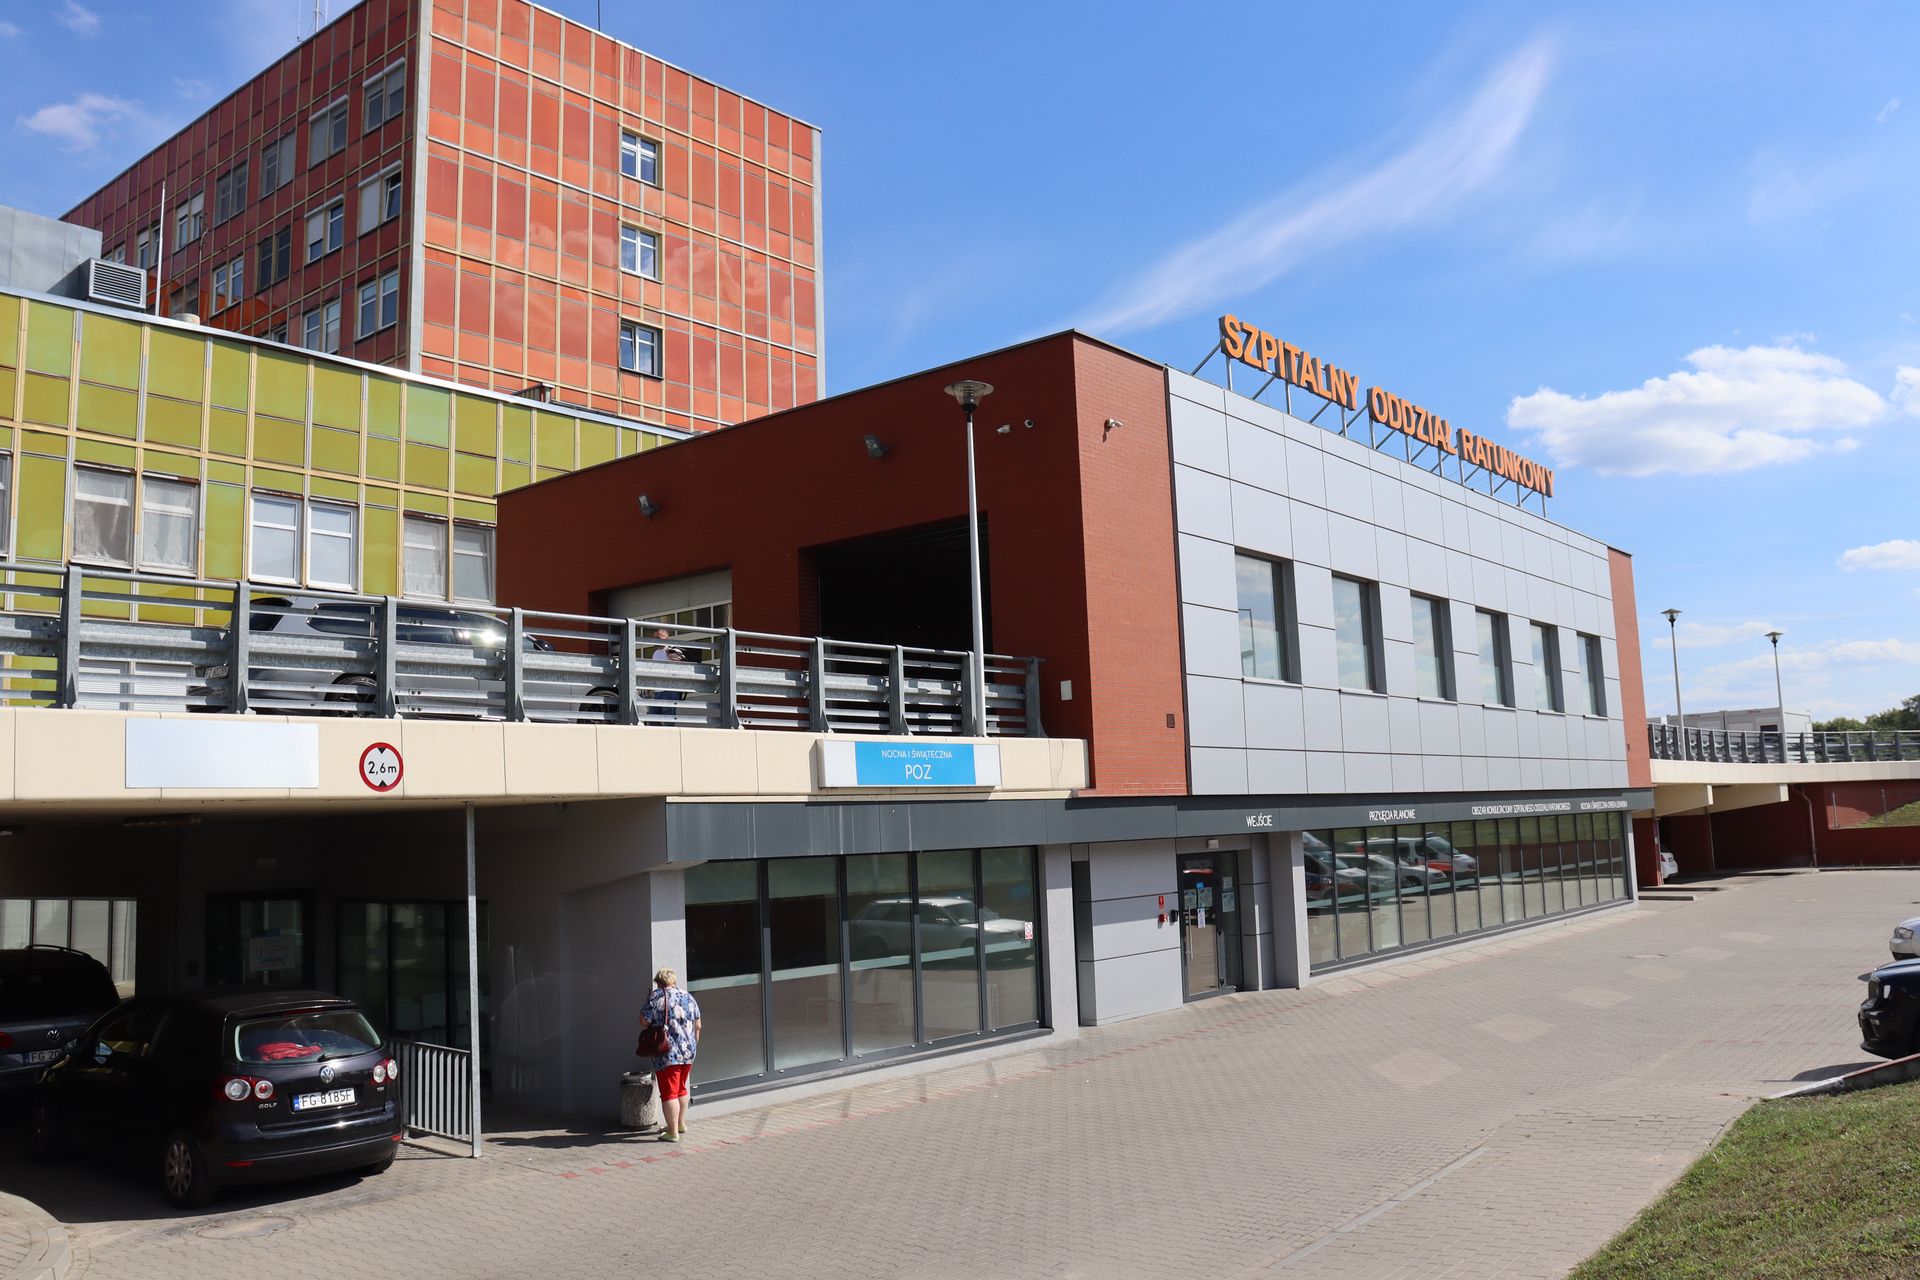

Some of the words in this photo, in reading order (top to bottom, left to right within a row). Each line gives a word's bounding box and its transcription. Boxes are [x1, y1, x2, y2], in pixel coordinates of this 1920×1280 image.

[1219, 314, 1359, 410] SZPITALNY
[1367, 386, 1457, 455] ODDZIAŁ
[1457, 428, 1555, 498] RATUNKOWY
[881, 749, 906, 759] NOCNA
[911, 748, 953, 760] ŚWIĄTECZNA
[905, 764, 932, 780] POZ
[1246, 813, 1273, 827] WEJŚCIE
[1393, 809, 1416, 820] PLANOWE
[302, 1092, 317, 1107] FG
[320, 1089, 351, 1105] 8185F
